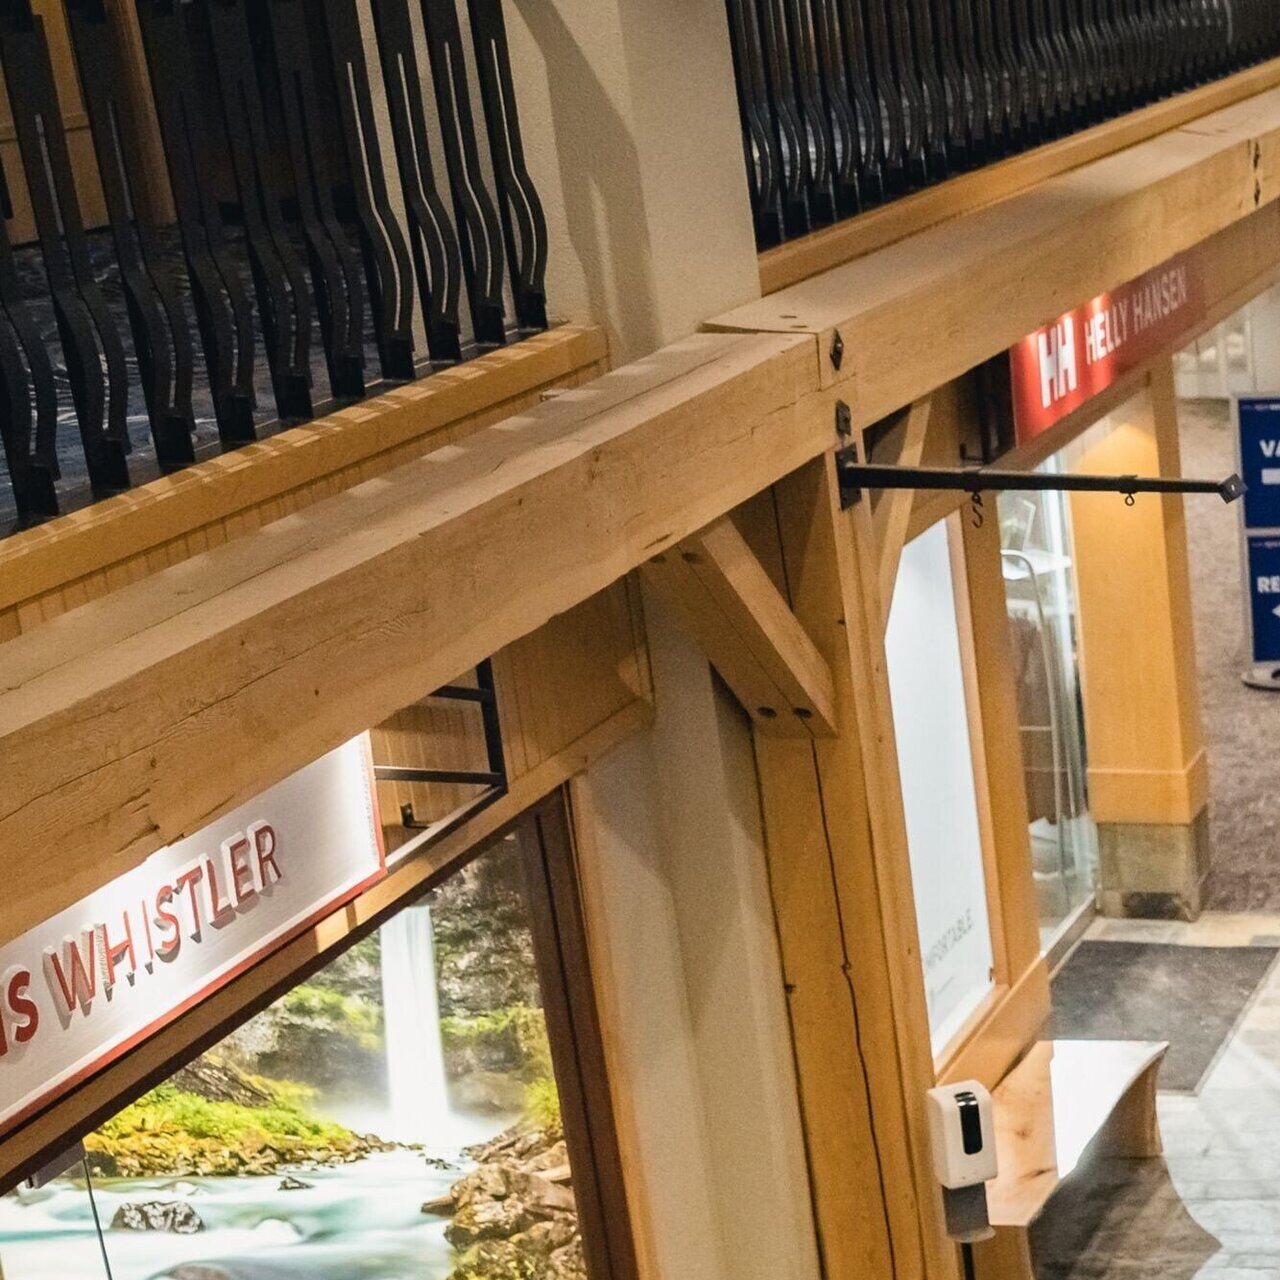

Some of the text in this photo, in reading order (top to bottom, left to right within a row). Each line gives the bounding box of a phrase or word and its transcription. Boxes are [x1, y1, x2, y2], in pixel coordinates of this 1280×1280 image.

[1085, 299, 1128, 366] HELLY
[1132, 265, 1187, 335] HANSEN
[47, 822, 282, 1013] WHISTLER
